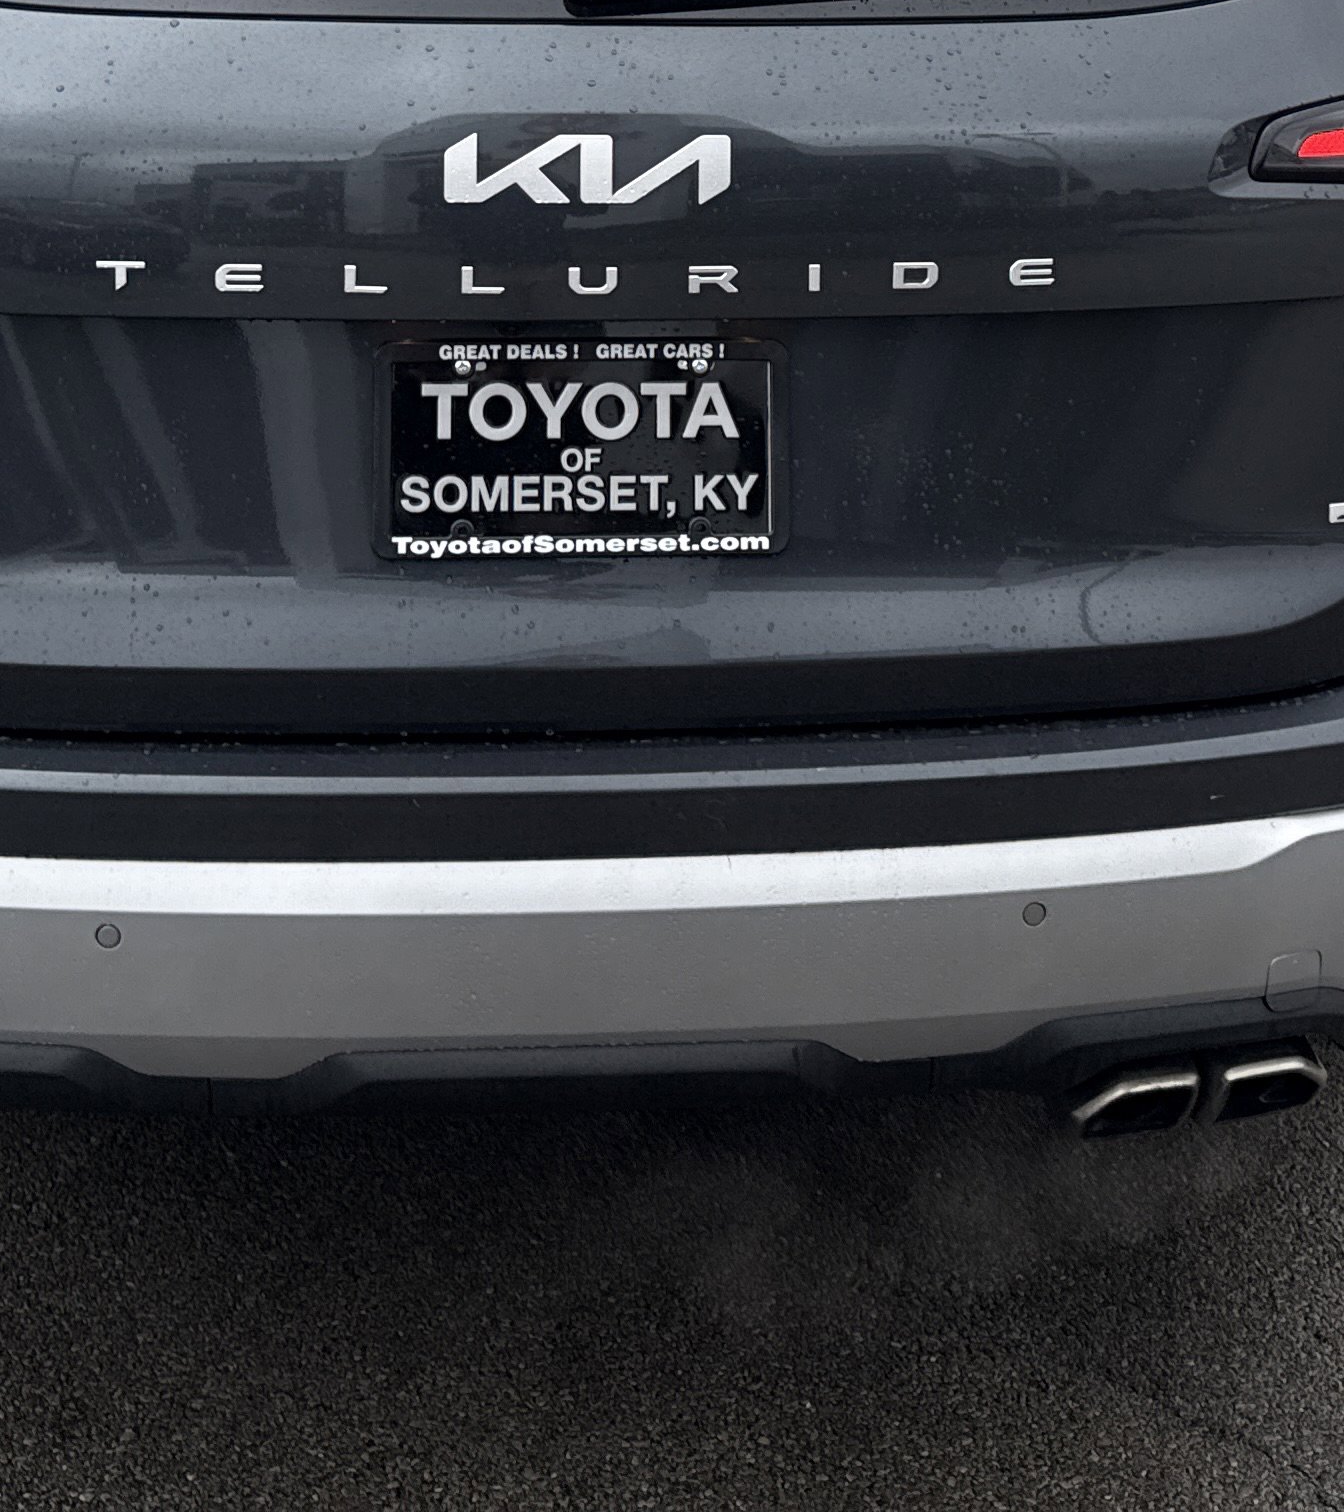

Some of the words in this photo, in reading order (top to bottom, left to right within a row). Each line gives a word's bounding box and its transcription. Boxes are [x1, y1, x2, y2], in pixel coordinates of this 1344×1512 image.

[95, 257, 1055, 295] TELLURIDE
[438, 344, 502, 361] GREAT
[595, 343, 656, 359] GREAT
[421, 382, 740, 441] TOYOTA
[560, 447, 602, 473] OF
[400, 474, 677, 518] SOMERSET,
[693, 473, 759, 511] KY
[391, 533, 771, 559] ToyotaofSomerset.com
